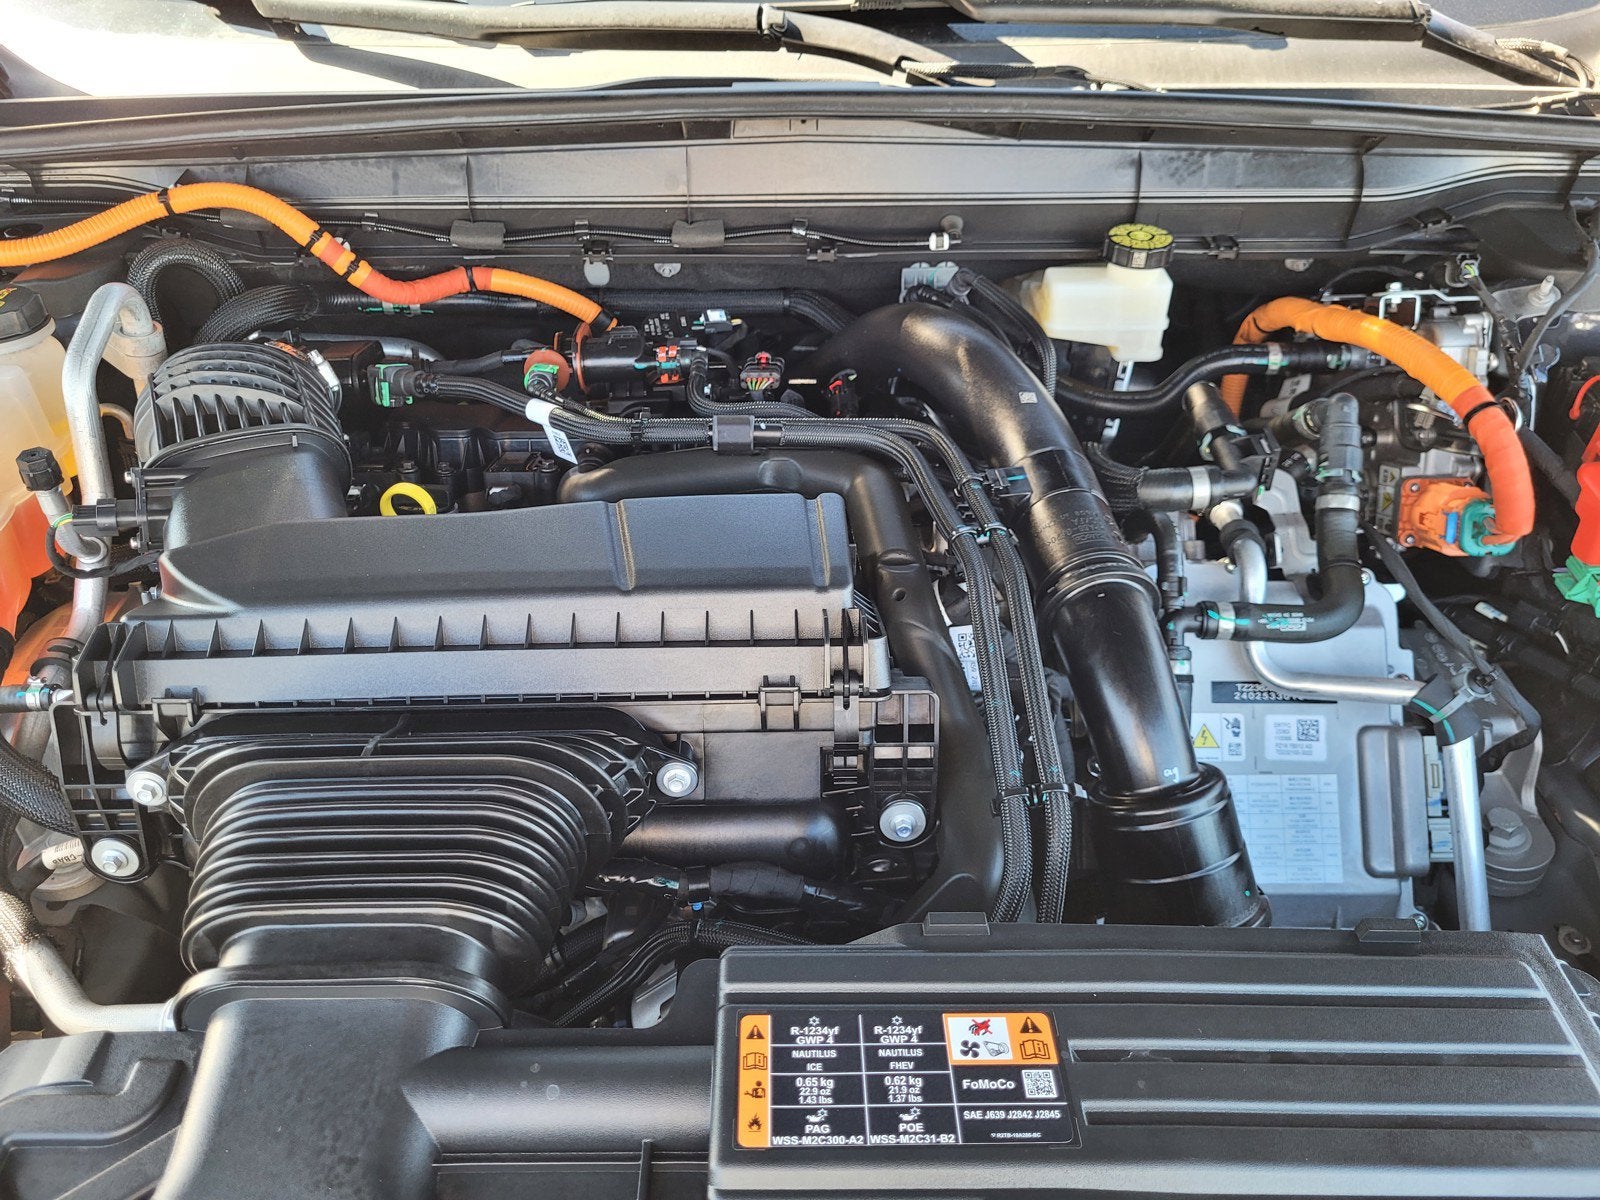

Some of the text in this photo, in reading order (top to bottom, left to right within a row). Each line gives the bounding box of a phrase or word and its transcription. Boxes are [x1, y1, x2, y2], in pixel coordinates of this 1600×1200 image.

[790, 1026, 840, 1036] R-1234yf
[874, 1026, 923, 1036] R-1234yf
[796, 1035, 834, 1044] GWP 4
[880, 1035, 918, 1044] GWP 4
[792, 1050, 837, 1058] NAUTILUS
[878, 1048, 923, 1057] NAUTILUS
[806, 1063, 823, 1071] ICE
[889, 1061, 914, 1069] FHEV
[795, 1078, 834, 1088] 0.65 kg
[884, 1076, 922, 1087] 0.62 kg
[962, 1079, 1016, 1089] FoMoCo
[799, 1087, 818, 1095] 22.9
[888, 1086, 907, 1094] 21.9
[798, 1096, 832, 1104] 1.43 lbs
[963, 1110, 1061, 1119] SAE J639 J2842 J2845
[805, 1125, 830, 1133] PAG
[898, 1123, 924, 1132] POE
[772, 1136, 864, 1145] WSS-M2C300-A2
[870, 1134, 956, 1144] WSS-M2C31-B2
